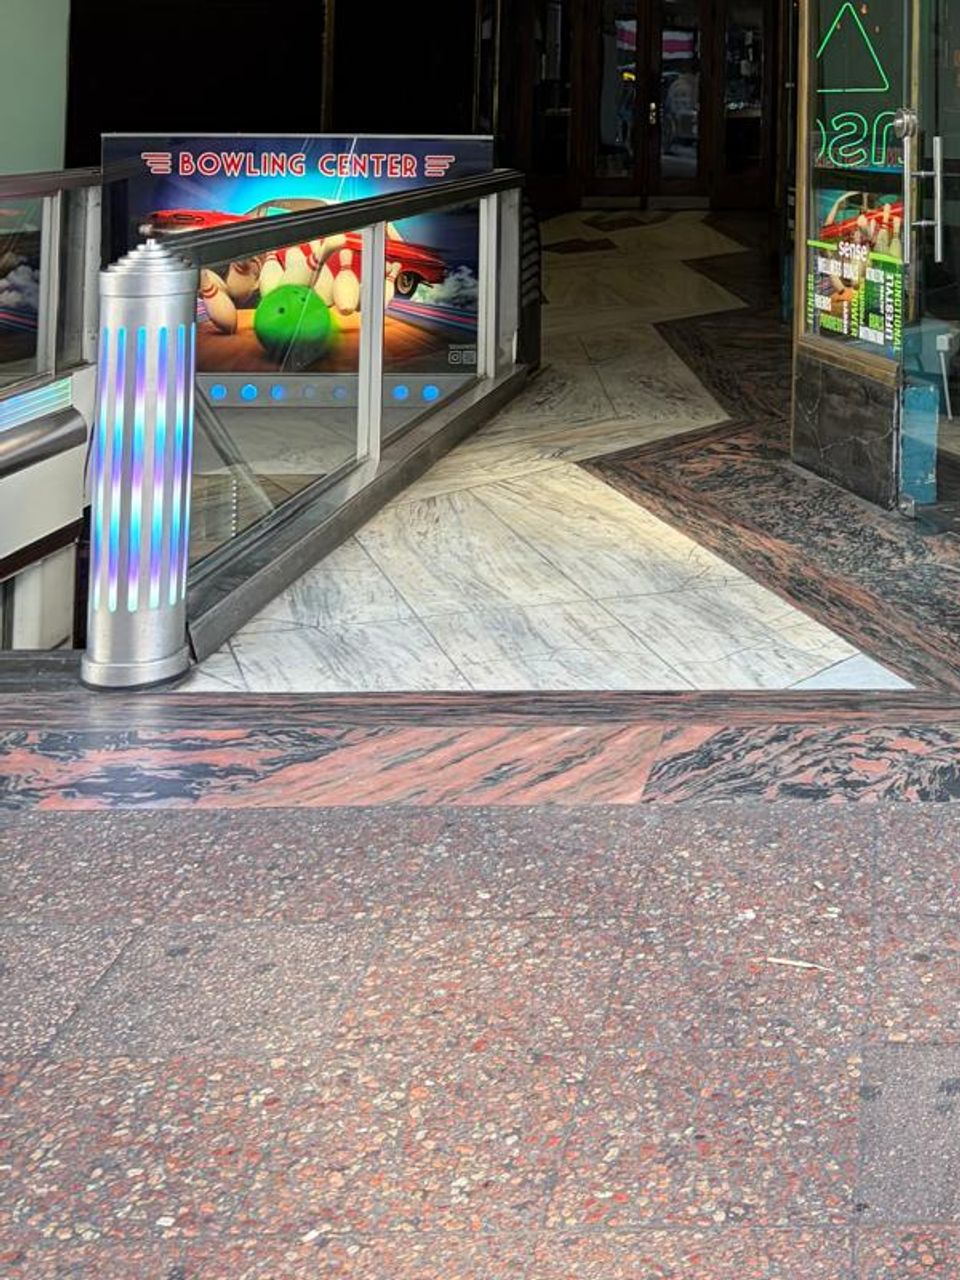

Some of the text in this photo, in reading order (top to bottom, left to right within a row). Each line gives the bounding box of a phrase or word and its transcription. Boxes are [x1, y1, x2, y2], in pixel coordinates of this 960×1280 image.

[178, 152, 417, 178] BOWLING CENTER
[838, 241, 868, 262] sense
